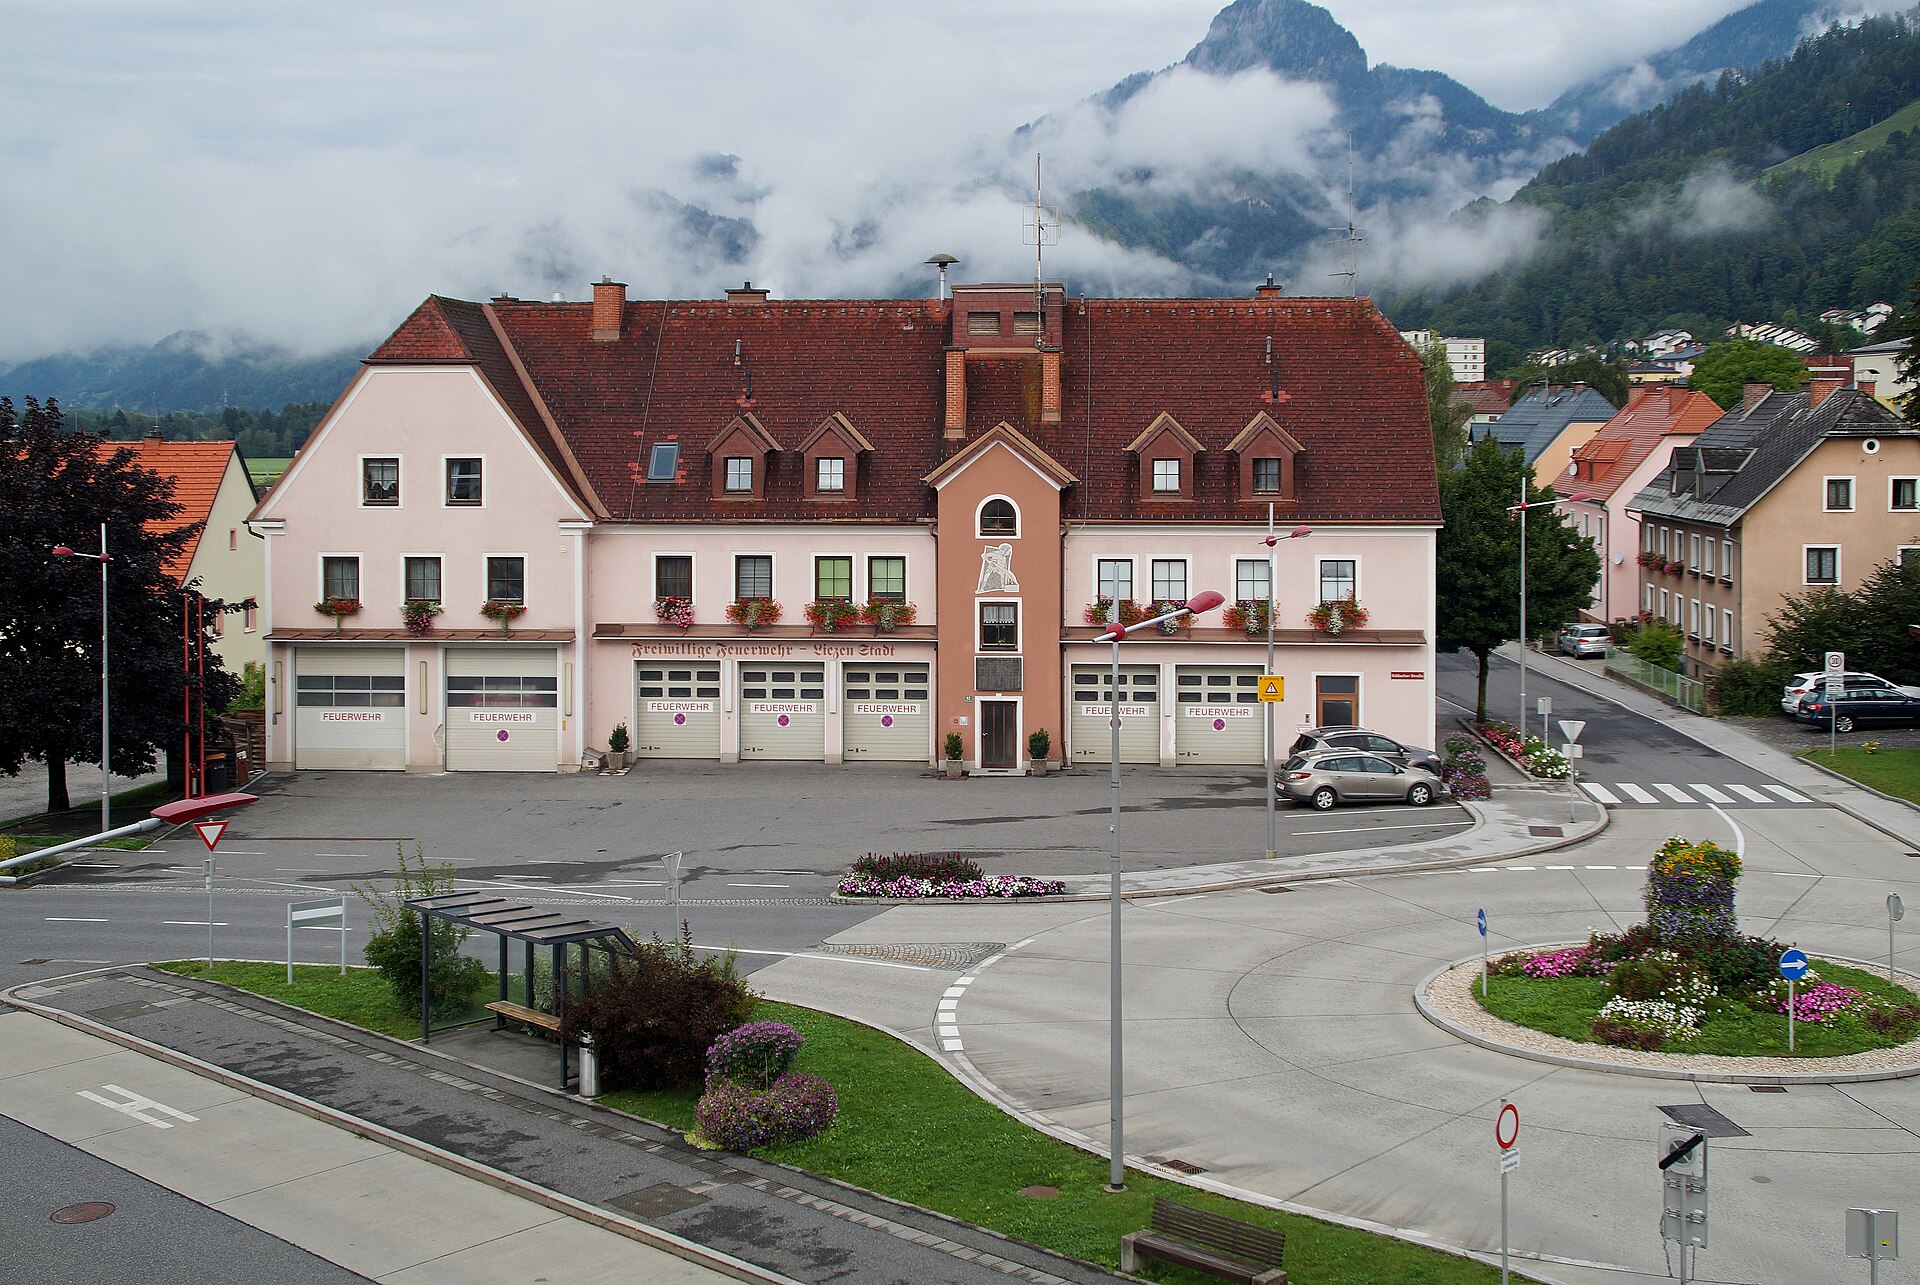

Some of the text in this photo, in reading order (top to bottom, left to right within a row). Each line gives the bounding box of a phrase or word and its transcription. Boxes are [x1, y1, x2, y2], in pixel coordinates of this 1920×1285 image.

[631, 642, 712, 658] Freiwillige
[716, 643, 793, 658] Feuerwehr
[813, 643, 854, 660] Liezen
[858, 643, 896, 657] Stadt
[651, 702, 710, 711] FEUERWEHR
[754, 704, 813, 713] FEUERWEHR
[857, 704, 917, 713] FEUERWEHR
[1085, 706, 1146, 715] FEUEWEHR
[323, 713, 382, 721] FEUERWEHR
[1189, 708, 1250, 717] FEUERWEHR
[473, 713, 533, 722] FEUERWEHR
